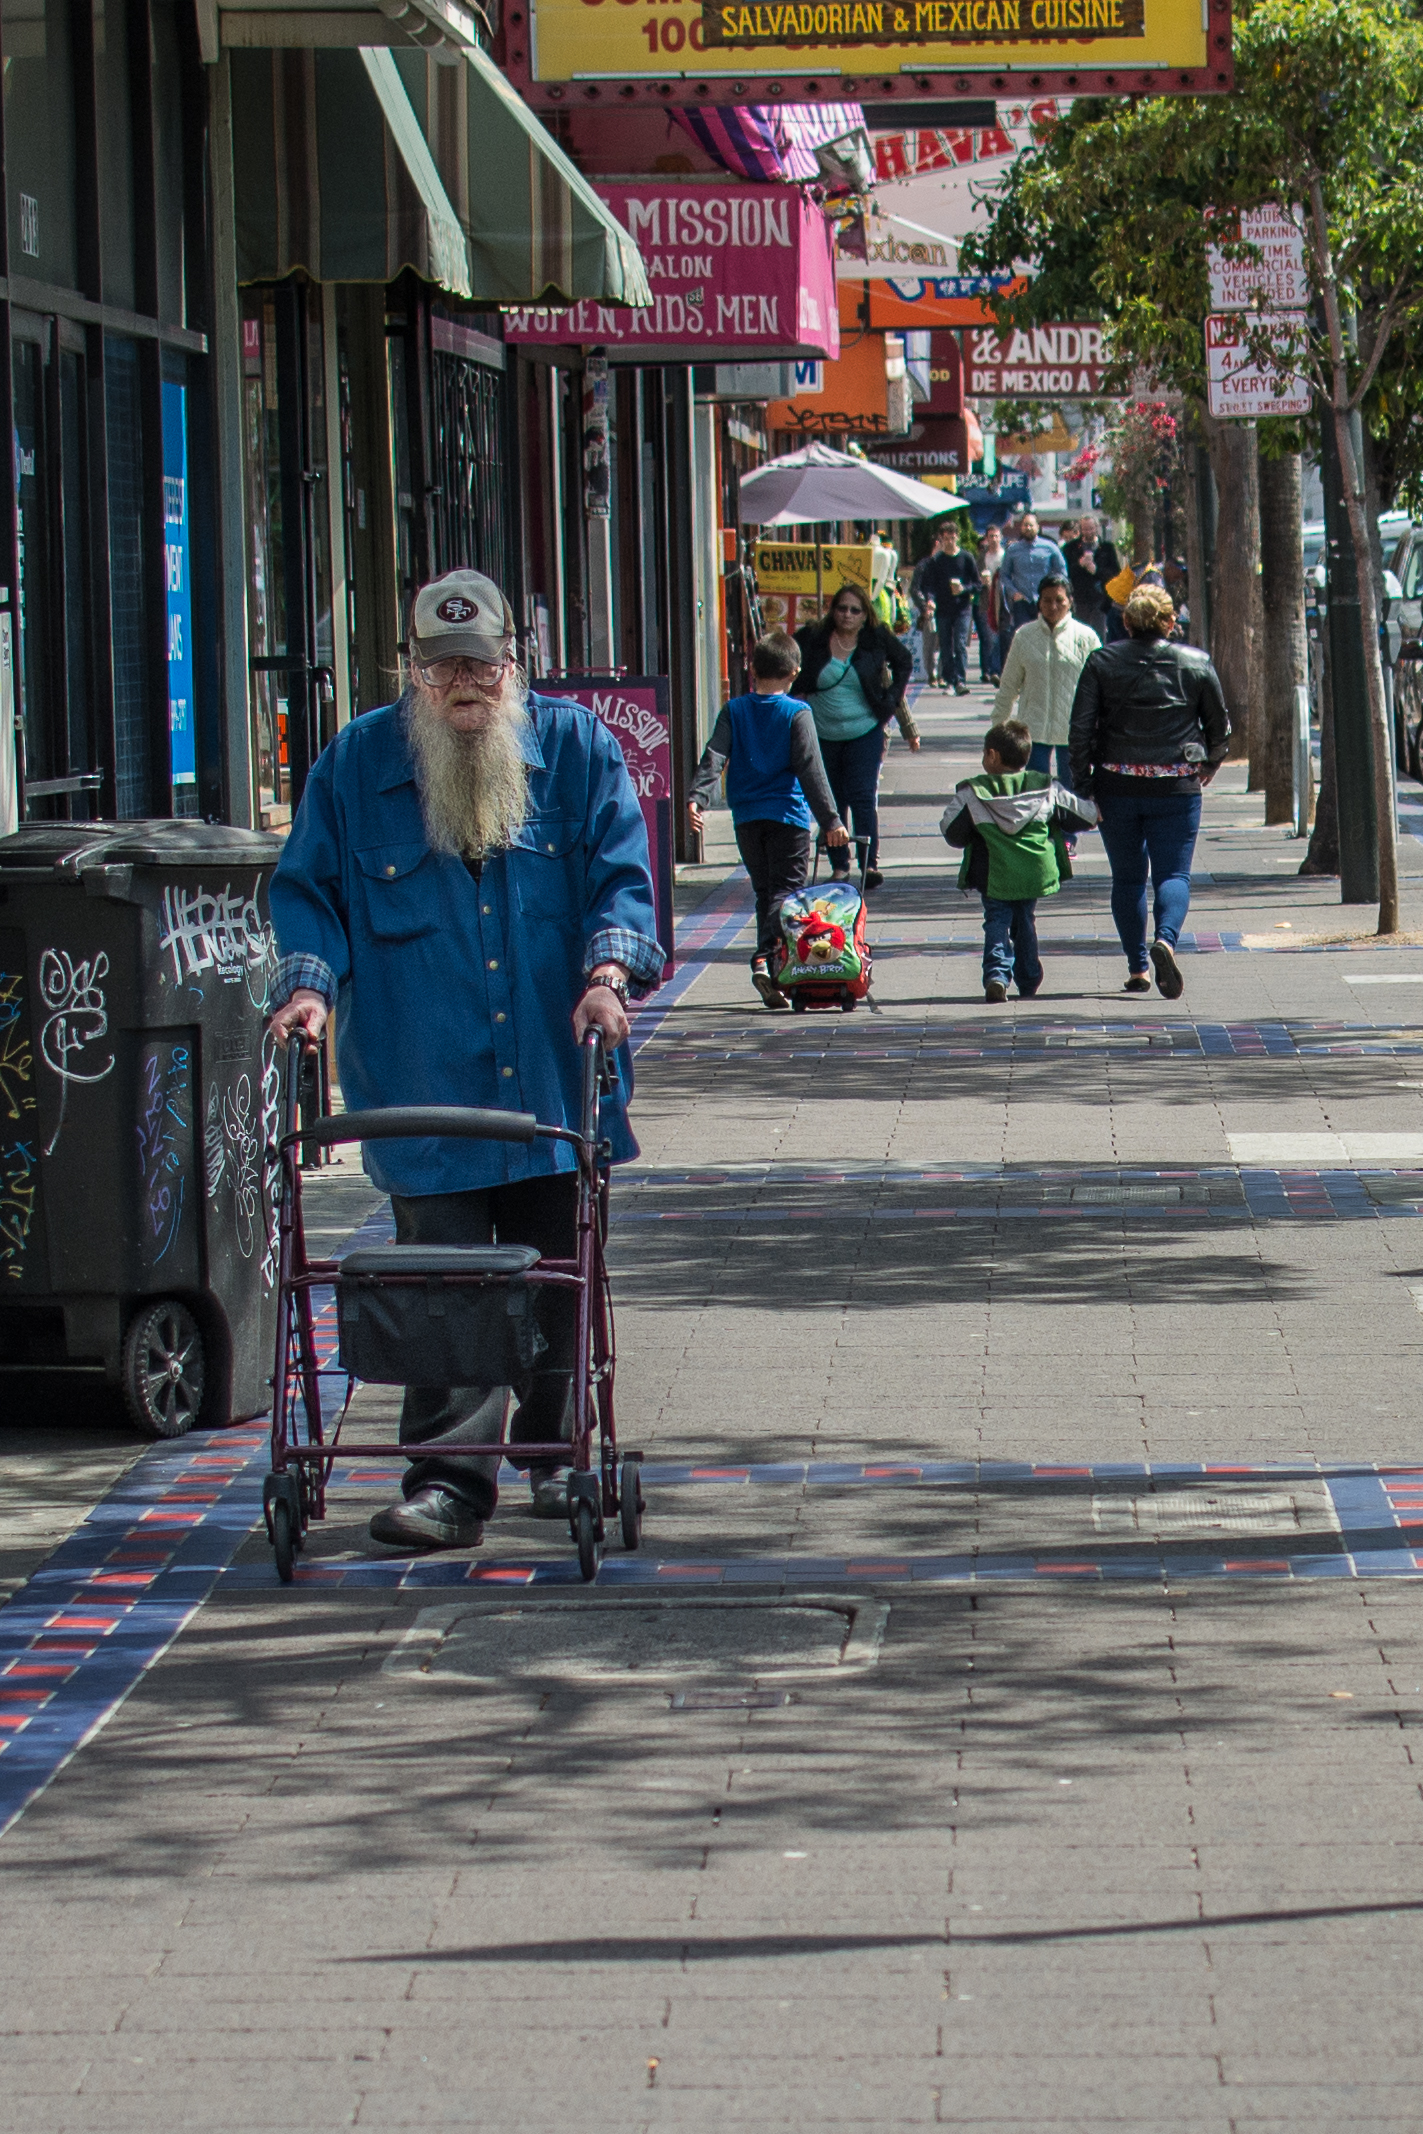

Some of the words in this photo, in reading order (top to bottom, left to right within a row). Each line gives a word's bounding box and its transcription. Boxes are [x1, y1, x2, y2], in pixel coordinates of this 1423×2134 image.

[722, 3, 884, 37] SALVADORIAN
[893, 8, 910, 32] &
[915, 1, 1020, 32] MEXICAN
[1030, 0, 1124, 29] CUISINE
[626, 198, 793, 248] MISSION
[1247, 226, 1297, 240] PARKING
[1261, 245, 1292, 258] TIME
[1213, 260, 1302, 275] COMMERCIAL
[1223, 273, 1294, 288] VEHICLES
[716, 294, 780, 335] MEN
[972, 371, 996, 392] DE
[1001, 370, 1073, 393] MEXICO
[1077, 371, 1092, 392] A
[1257, 400, 1302, 412] SWEEPING
[446, 599, 471, 620] SF
[591, 692, 670, 755] MISSION
